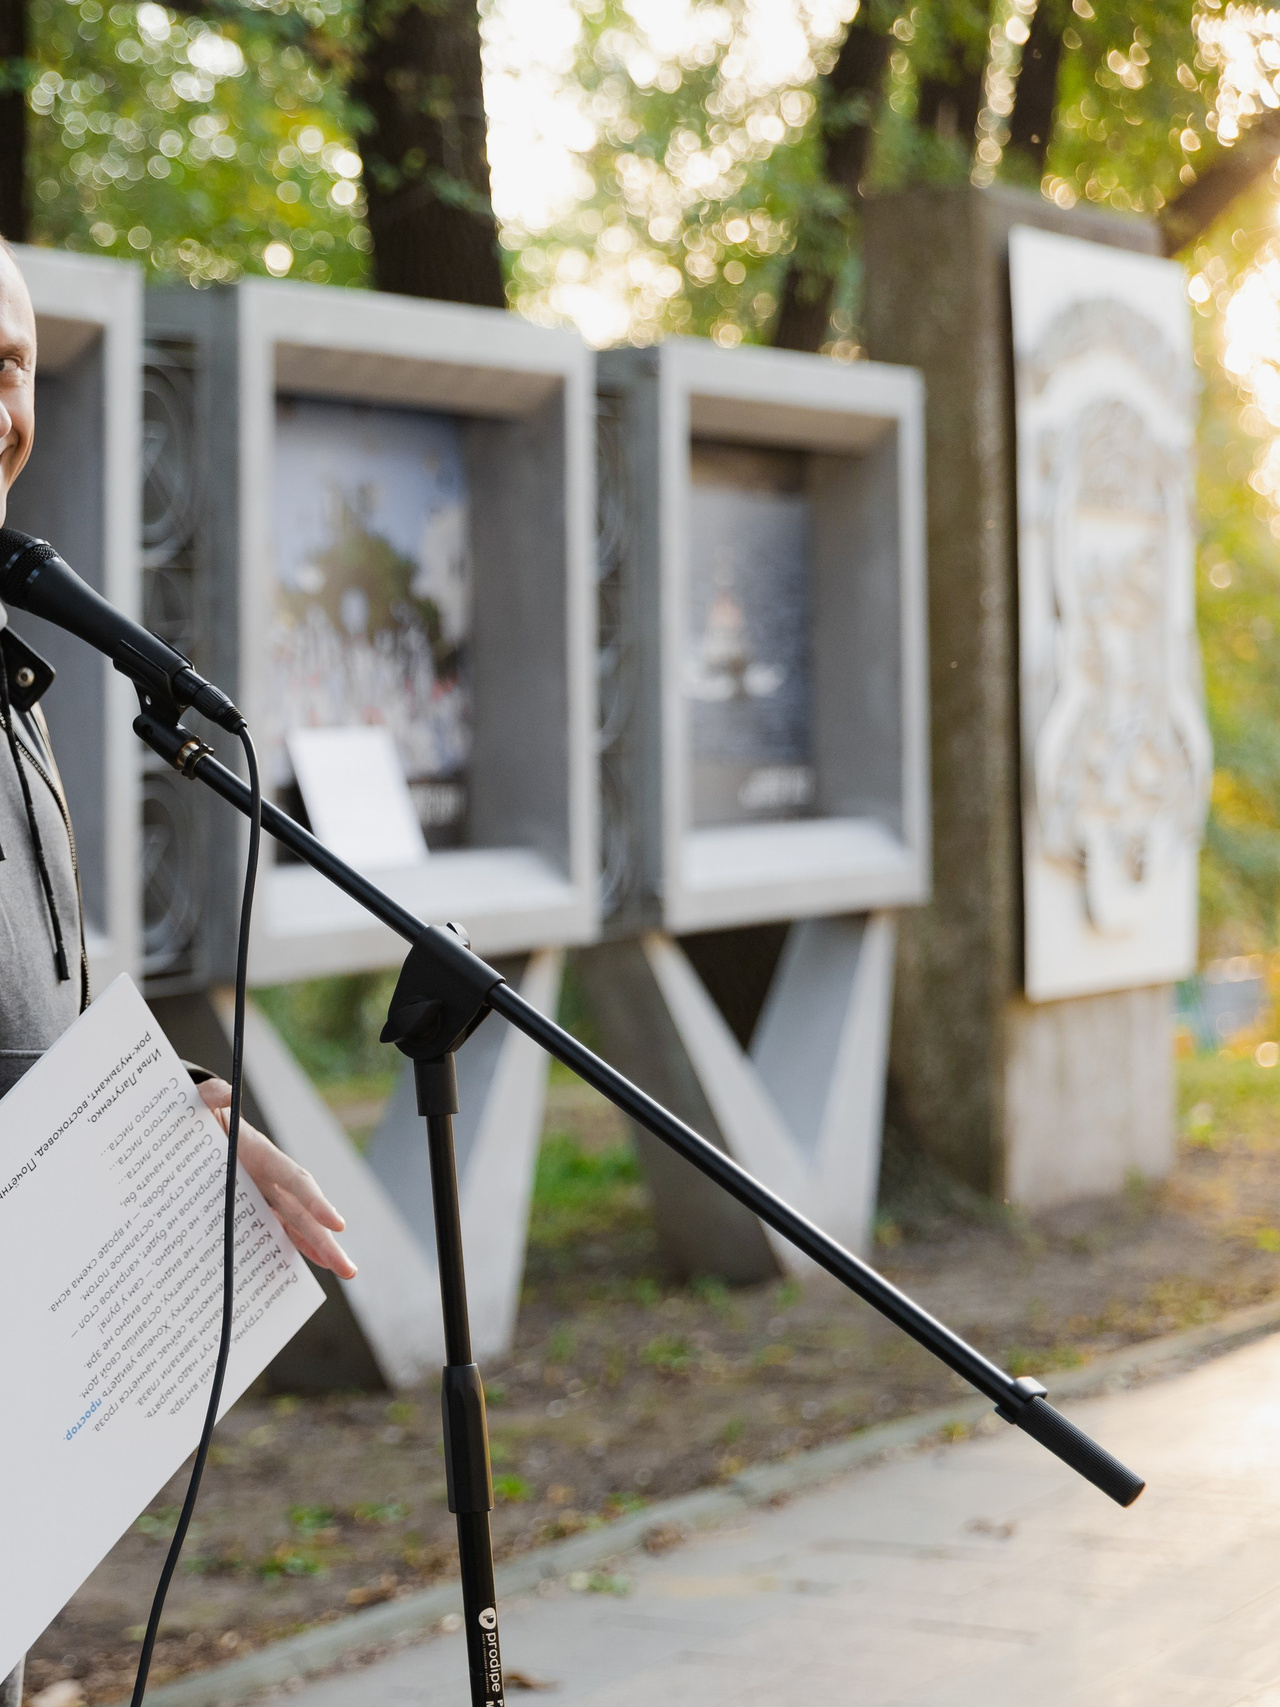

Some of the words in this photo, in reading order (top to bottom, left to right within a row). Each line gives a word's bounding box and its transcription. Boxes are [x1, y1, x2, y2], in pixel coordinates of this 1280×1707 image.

[86, 1030, 151, 1100] рок-музыкант,
[136, 1047, 161, 1074] Илья
[86, 1071, 137, 1122] Лагутенко,
[168, 1077, 178, 1089] С
[177, 1091, 186, 1103] С
[134, 1086, 169, 1122] чистого
[143, 1101, 177, 1137] чистого
[185, 1105, 195, 1117] С
[33, 1100, 88, 1156] востоковед,
[152, 1115, 186, 1151] чистого
[194, 1119, 204, 1131] С
[164, 1127, 194, 1160] начала
[175, 1133, 212, 1172] Сначала
[135, 1159, 164, 1190] начать
[184, 1147, 221, 1186] Сначала
[119, 1191, 137, 1206] бы,
[139, 1171, 175, 1207] любовь,
[152, 1185, 184, 1217] стулья,
[124, 1219, 132, 1229] и
[166, 1215, 178, 1229] не
[187, 1215, 199, 1229] не
[198, 1202, 255, 1262] Подбосишь
[250, 1218, 265, 1231] Ты
[97, 1227, 124, 1258] вроде
[109, 1218, 153, 1269] остальное
[138, 1229, 167, 1258] будет,
[151, 1229, 187, 1266] обидно,
[182, 1244, 194, 1258] не
[217, 1230, 250, 1267] слыл
[239, 1230, 272, 1266] Костры
[71, 1258, 97, 1288] схема
[99, 1258, 139, 1305] капризов
[152, 1257, 182, 1289] видно,
[200, 1266, 217, 1286] про
[236, 1244, 281, 1294] Мохнатым
[276, 1259, 290, 1272] Ты
[48, 1287, 71, 1311] ясна.
[79, 1268, 109, 1300] потом.
[121, 1293, 128, 1305] у
[127, 1277, 144, 1297] сам
[141, 1290, 153, 1305] но
[160, 1263, 199, 1305] монетку,
[185, 1266, 237, 1323] оеняются,
[249, 1269, 275, 1301] думал
[264, 1272, 298, 1308] Ржавые
[78, 1304, 99, 1328] стол
[97, 1301, 121, 1334] руля!
[168, 1286, 199, 1320] клетку.
[114, 1304, 141, 1336] видно
[121, 1305, 161, 1350] оставишь
[101, 1335, 114, 1350] не
[136, 1320, 171, 1357] Хочешь
[156, 1324, 186, 1359] сейчас
[199, 1342, 213, 1359] тут
[213, 1334, 219, 1342] а
[83, 1349, 102, 1368] зря.
[99, 1351, 121, 1378] свой
[160, 1334, 198, 1379] завязали
[177, 1358, 198, 1383] надо
[79, 1374, 99, 1398] дом.
[101, 1355, 136, 1397] увидеть
[118, 1358, 157, 1403] начнётся
[135, 1378, 160, 1405] глаза.
[144, 1383, 177, 1417] нырять.
[167, 1382, 198, 1414] янтарь.
[63, 1397, 102, 1440] простор.
[91, 1402, 118, 1431] гроза.
[485, 1632, 501, 1692] prodipe
